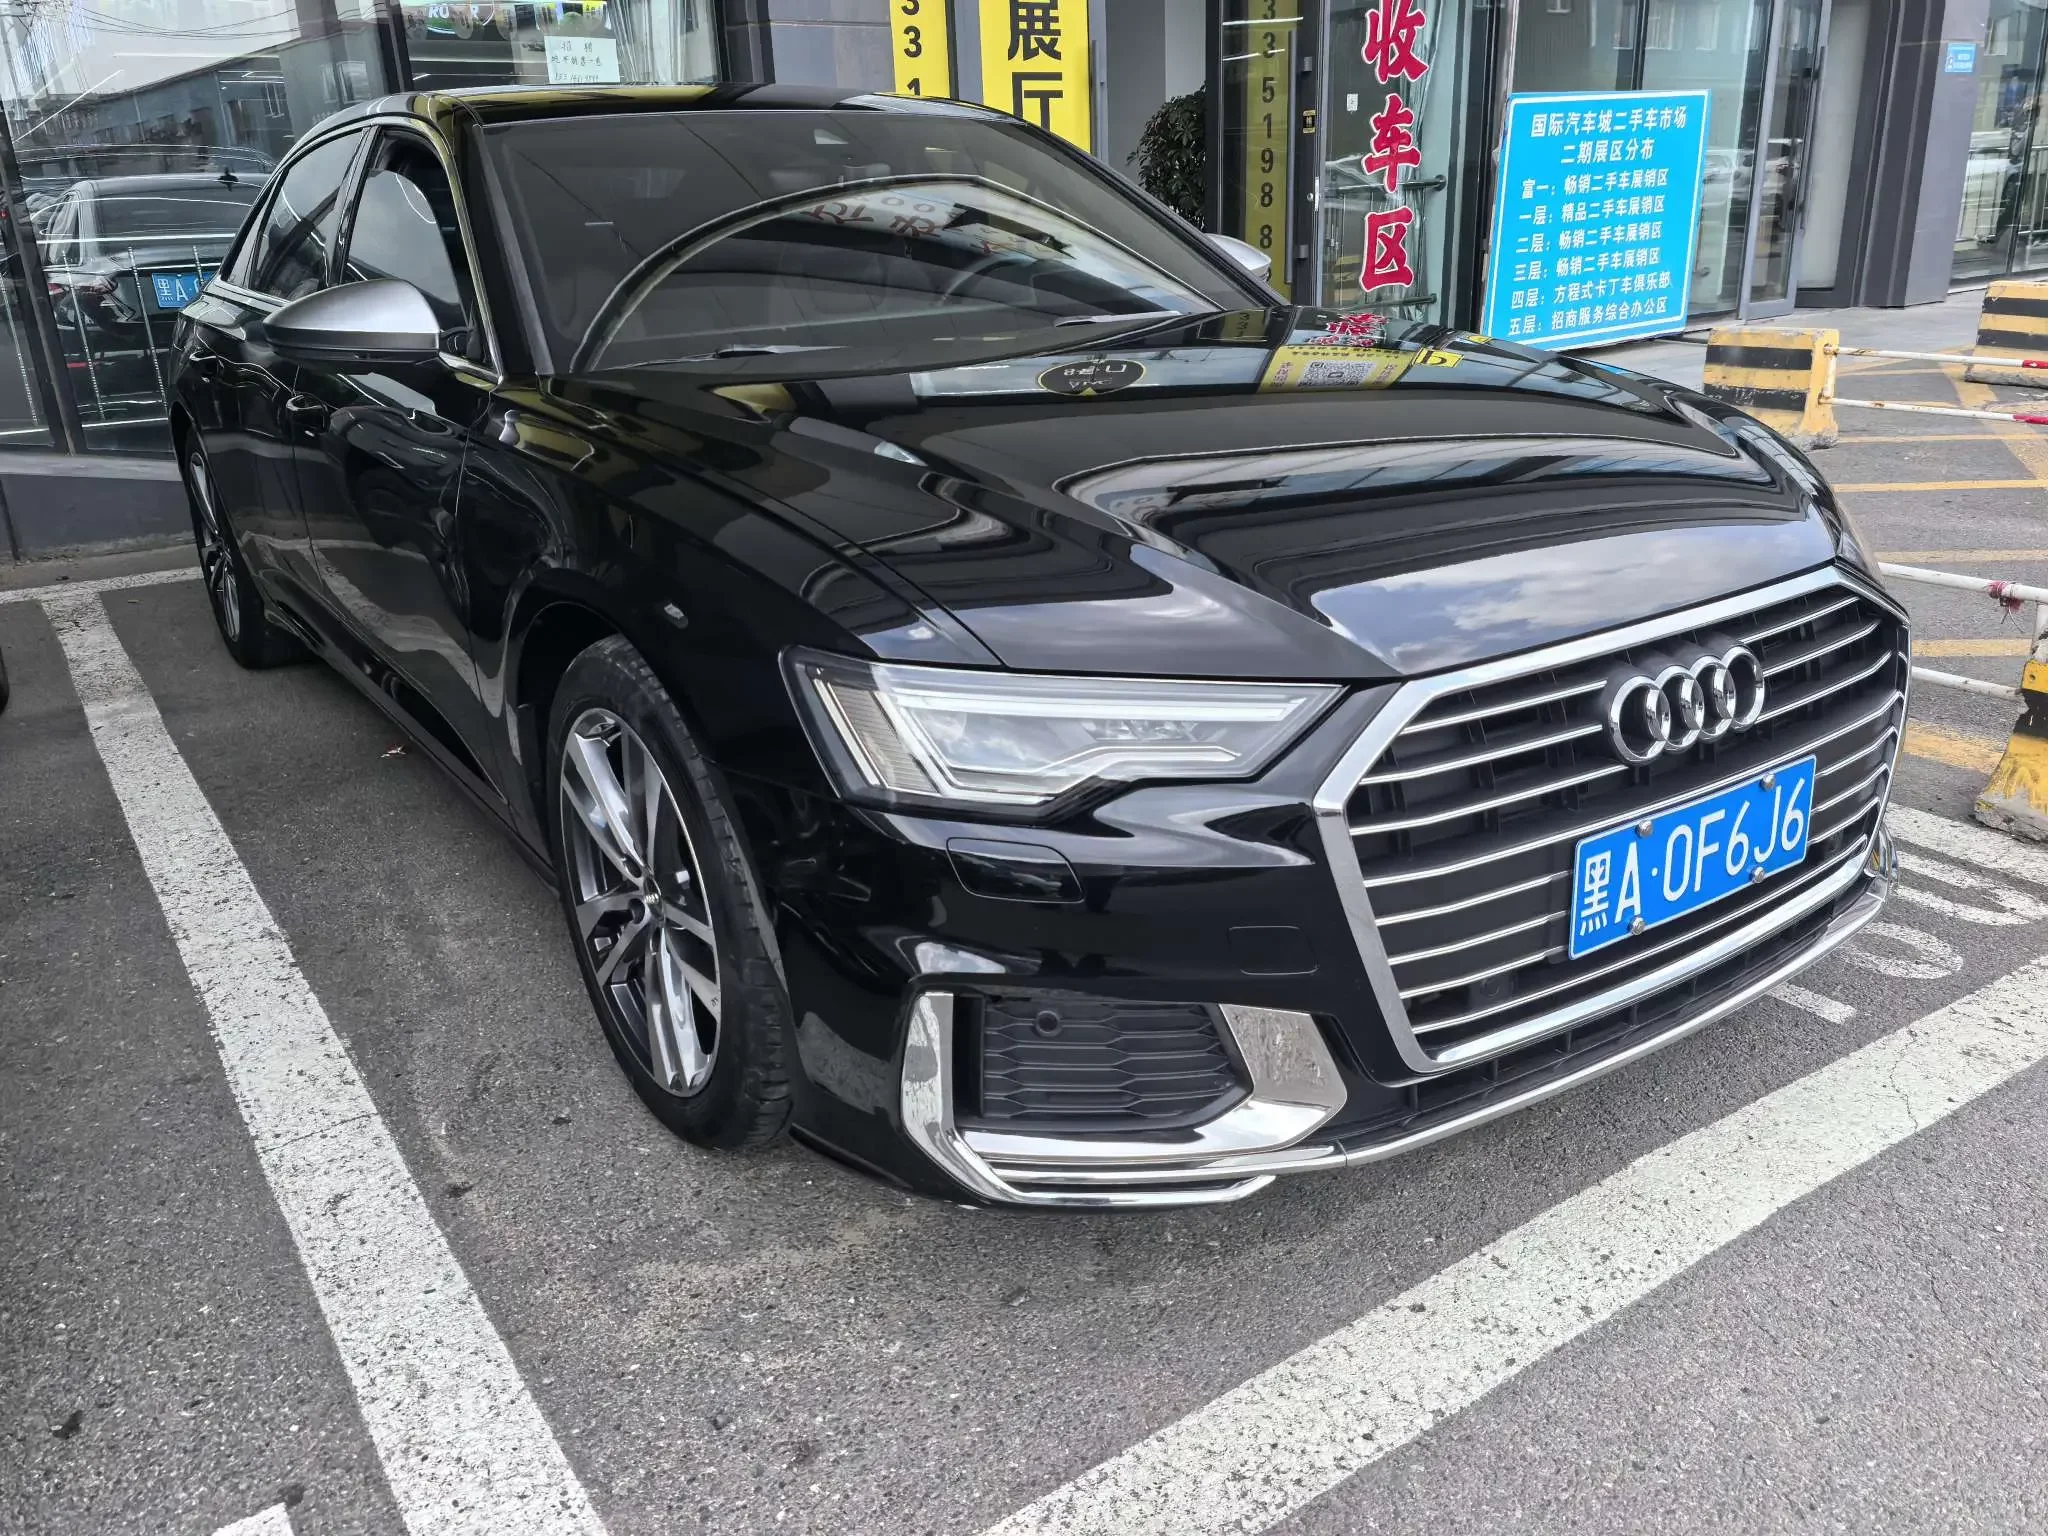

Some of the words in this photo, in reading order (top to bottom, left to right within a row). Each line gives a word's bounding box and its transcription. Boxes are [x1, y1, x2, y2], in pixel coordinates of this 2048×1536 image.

[1007, 0, 1063, 129] 展厅
[1361, 0, 1429, 292] 收车区
[1531, 105, 1687, 137] 国际汽车城二手车市场
[1561, 138, 1655, 164] 二期展区分布
